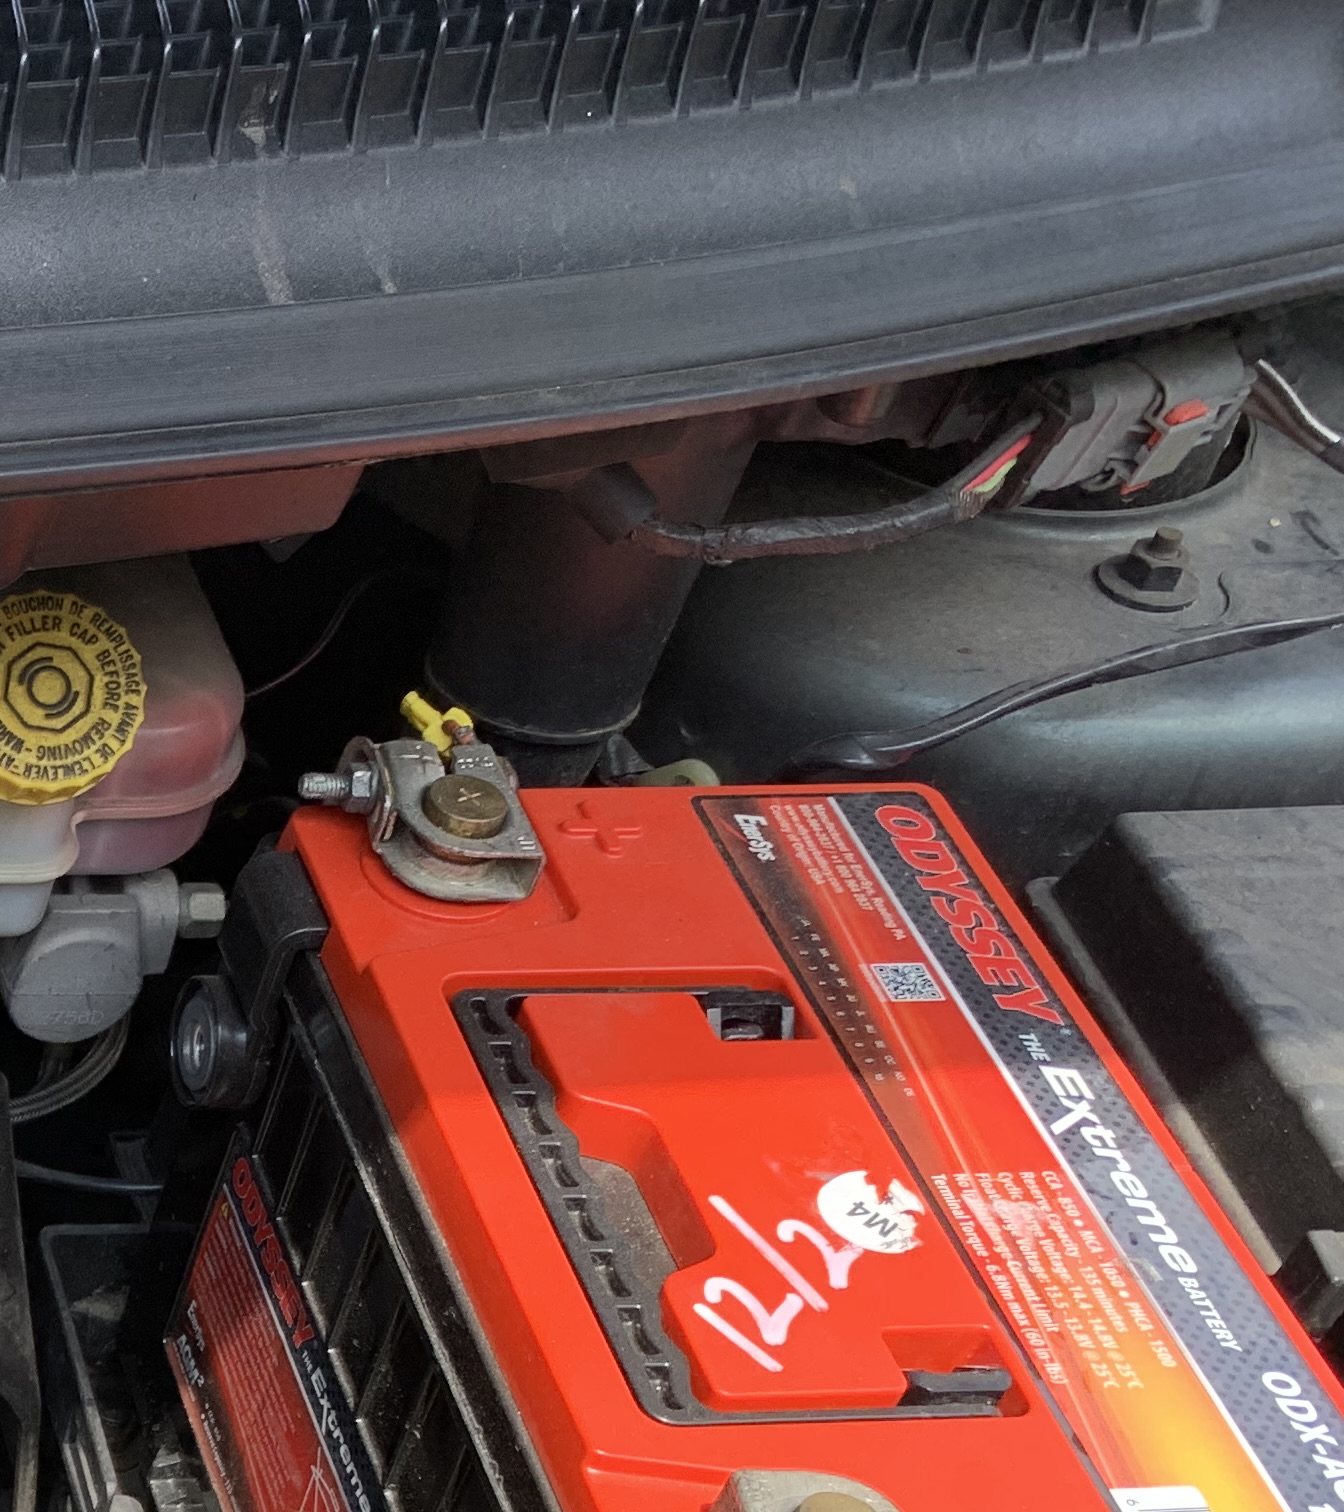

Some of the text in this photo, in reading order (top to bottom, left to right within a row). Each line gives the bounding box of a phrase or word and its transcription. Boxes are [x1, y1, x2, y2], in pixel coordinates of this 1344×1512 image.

[2, 596, 62, 620] BOUCHON
[6, 616, 62, 642] FILLER
[69, 622, 98, 646] CAP
[70, 601, 87, 620] DE
[90, 613, 141, 696] REMPLISSAGE
[96, 649, 121, 713] BEFORE
[36, 717, 111, 761] REMOVING
[113, 702, 139, 746] AVANT
[734, 814, 776, 863] EnerSys
[807, 868, 826, 885] USA
[813, 804, 850, 853] Manufactured
[843, 852, 856, 864] for
[890, 928, 907, 941] PA
[874, 805, 1064, 1029] ODYSSEY
[1016, 1031, 1243, 1353] THE Extreme BATTERY
[232, 1156, 315, 1348] ODYSSEY
[931, 1173, 964, 1220] Terminal
[959, 1218, 989, 1258] Torque
[1007, 1301, 1032, 1327] max
[1020, 1326, 1046, 1347] (60
[952, 1173, 967, 1190] No
[1006, 1259, 1039, 1301] Current
[1029, 1301, 1059, 1333] Limit
[975, 1171, 1001, 1204] Float
[1014, 1236, 1052, 1284] Voltage:
[1044, 1283, 1069, 1309] 13.5
[1064, 1317, 1096, 1348] 13.8V
[997, 1171, 1023, 1203] Cyclic
[1038, 1237, 1075, 1284] Voltage:
[1068, 1284, 1092, 1310] 14.4
[1088, 1318, 1119, 1349] 14.8V
[1019, 1171, 1129, 1334] Reserve Capacity 135 minutes
[1042, 1170, 1177, 1369] CCA 850 MCA 1050 PHCA 1500
[1126, 1499, 1139, 1507] 6
